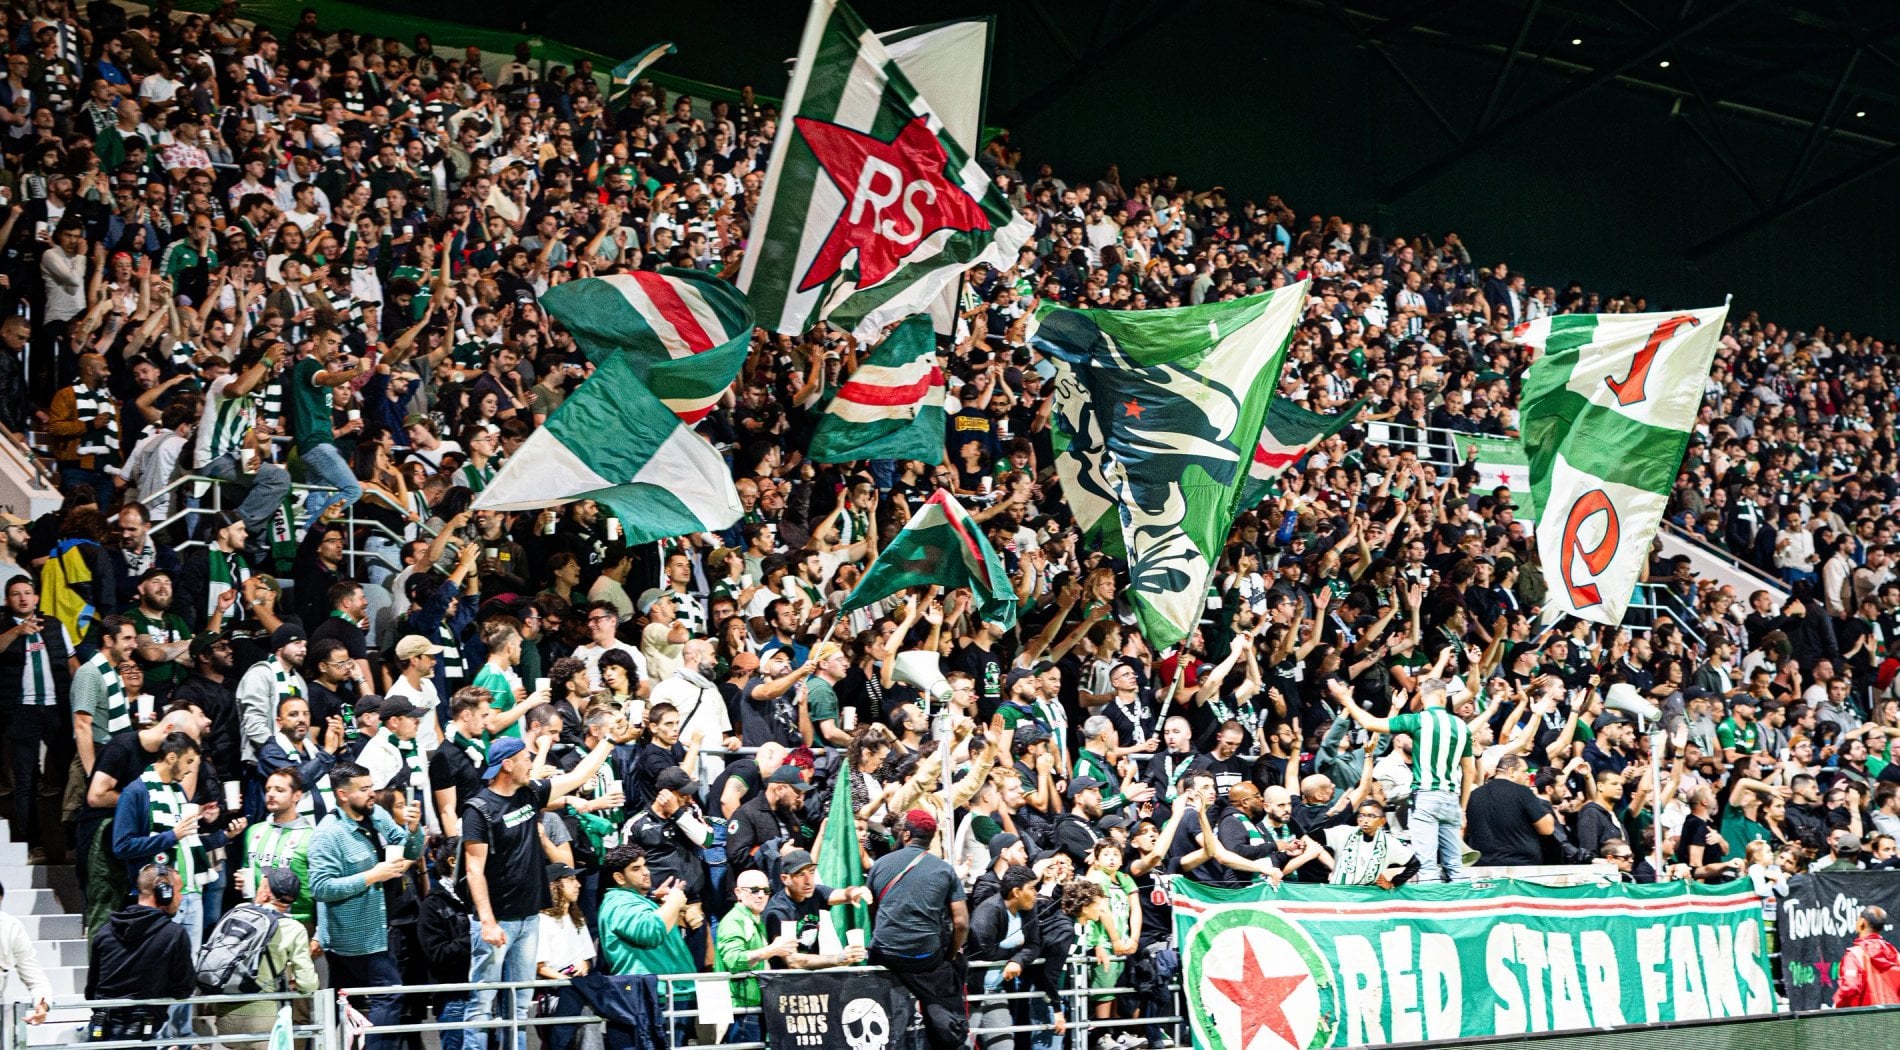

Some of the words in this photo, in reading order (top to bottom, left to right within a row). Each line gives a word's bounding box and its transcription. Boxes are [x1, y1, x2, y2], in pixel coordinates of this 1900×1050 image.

[847, 154, 937, 245] RS
[786, 1014, 828, 1034] BOYS
[1333, 925, 1463, 1046] RED
[1485, 922, 1627, 1035] STAR
[1635, 917, 1773, 1024] FANS
